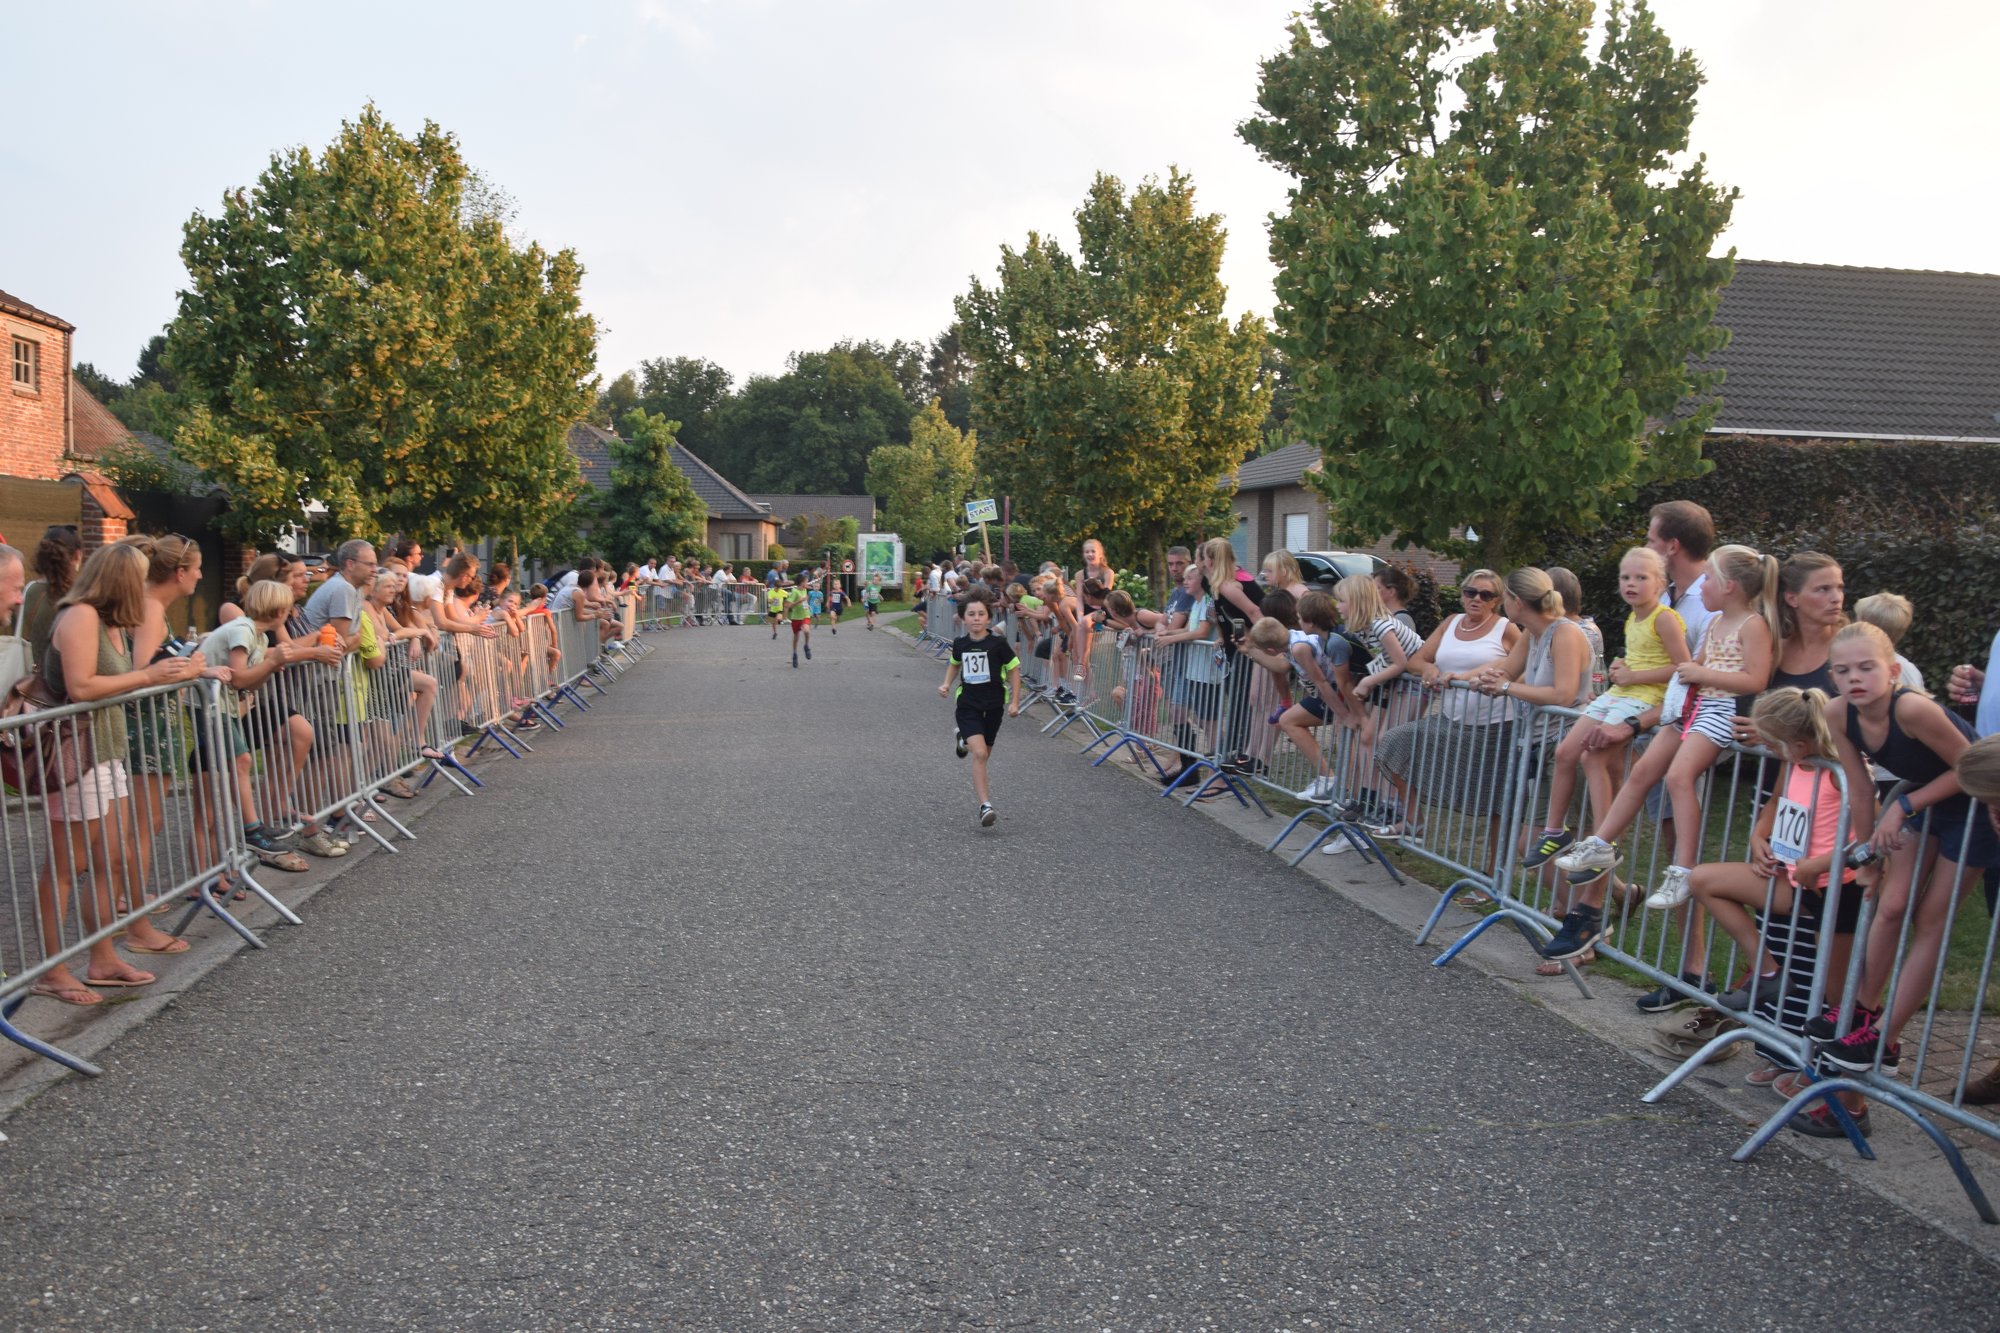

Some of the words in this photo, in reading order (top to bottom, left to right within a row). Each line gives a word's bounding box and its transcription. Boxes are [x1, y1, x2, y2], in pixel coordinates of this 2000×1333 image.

[970, 504, 994, 518] START
[964, 655, 986, 673] 137
[1779, 804, 1807, 846] 170
